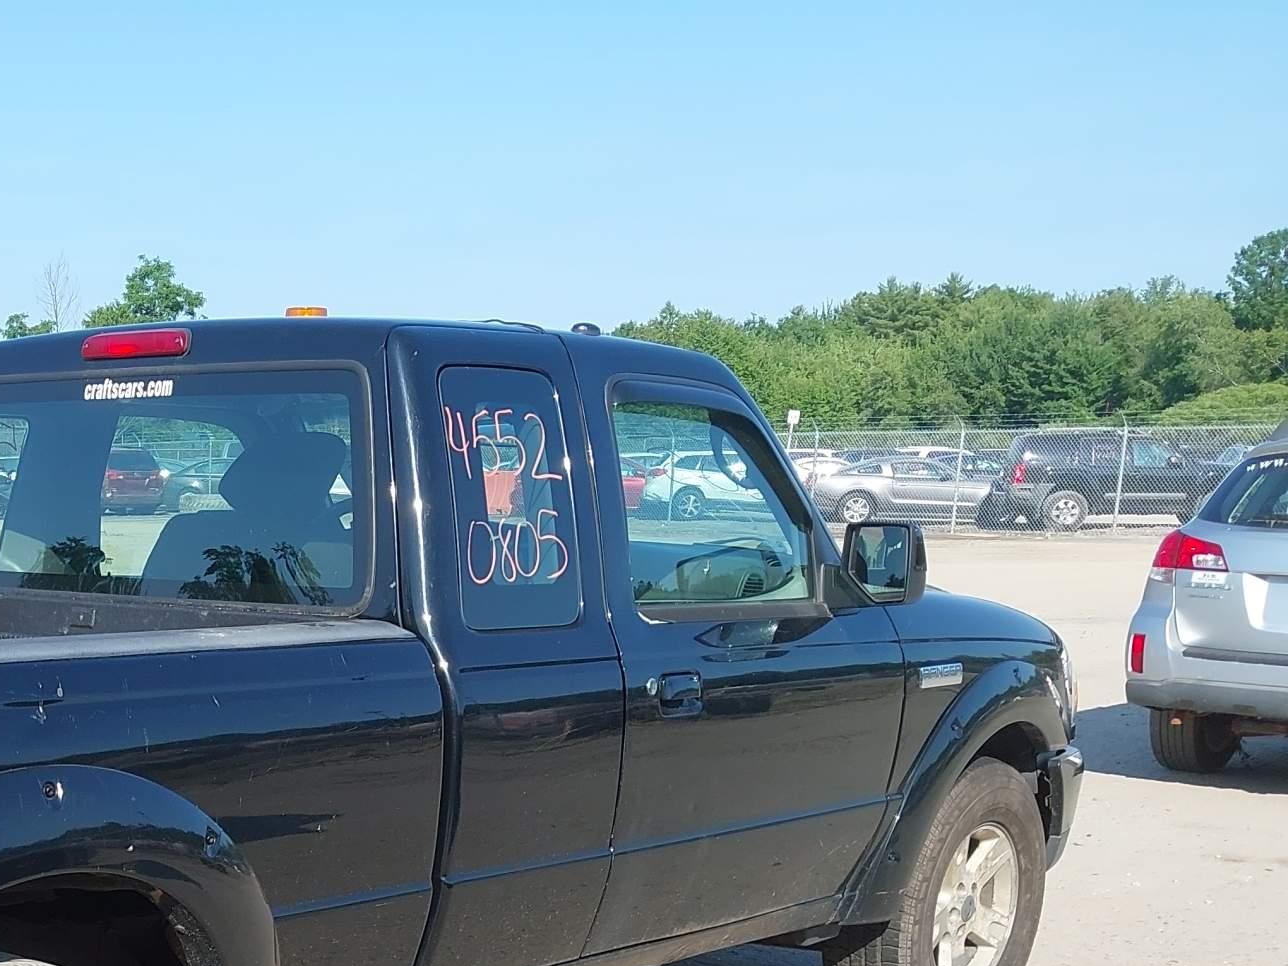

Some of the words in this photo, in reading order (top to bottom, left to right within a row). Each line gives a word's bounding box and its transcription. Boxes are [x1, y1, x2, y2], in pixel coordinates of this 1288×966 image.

[83, 378, 174, 400] craftscars.com
[444, 406, 563, 480] 4552
[467, 508, 569, 585] 0805
[921, 663, 962, 680] RANGER
